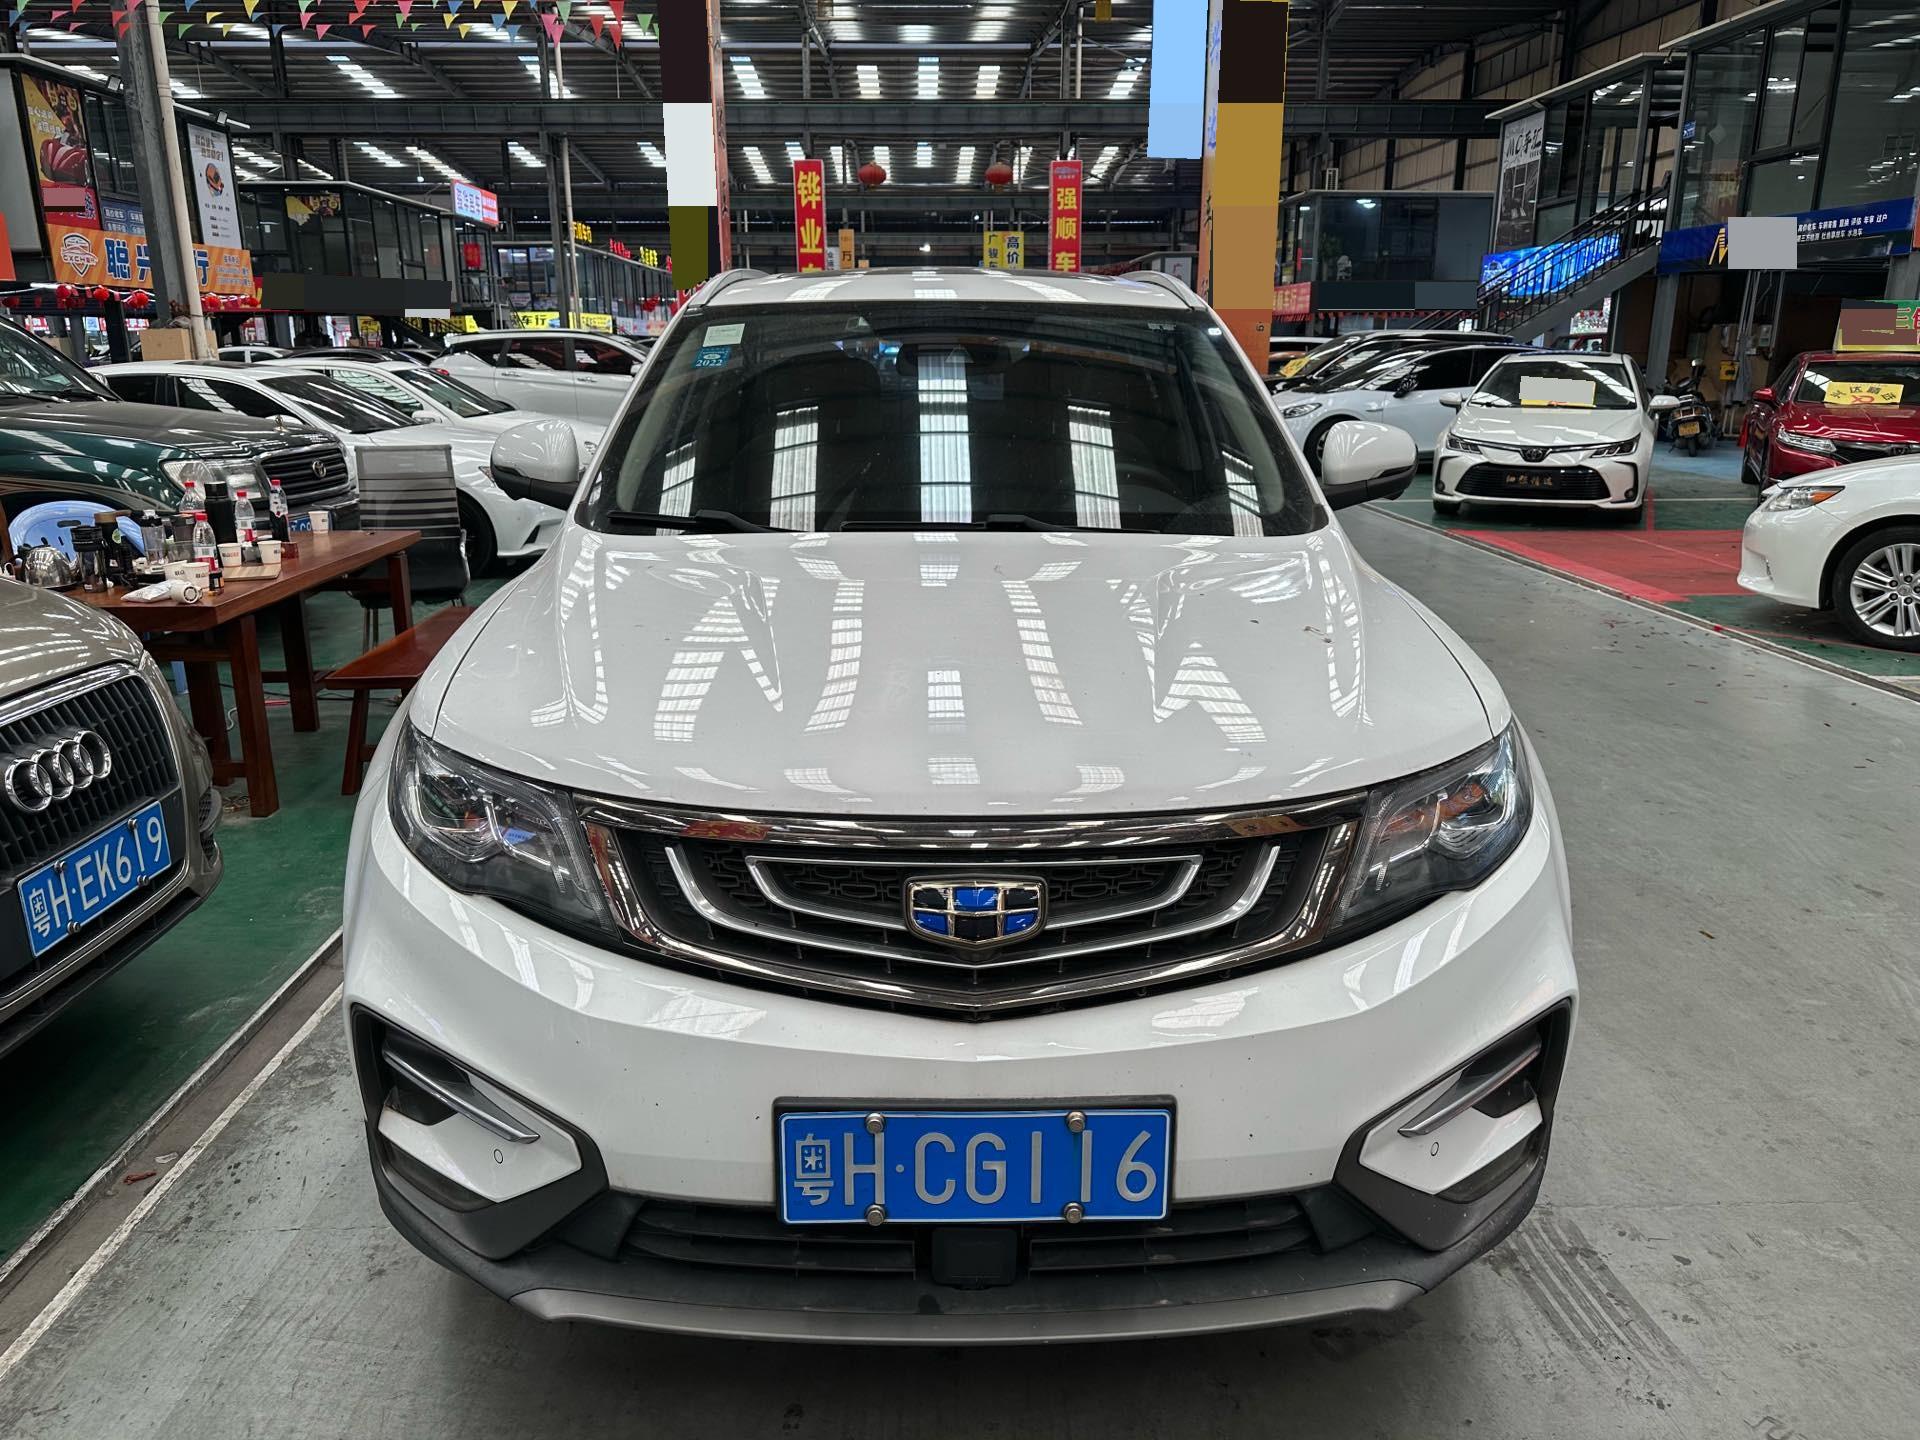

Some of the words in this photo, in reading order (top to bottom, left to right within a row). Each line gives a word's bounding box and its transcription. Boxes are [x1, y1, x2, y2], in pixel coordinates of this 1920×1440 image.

[1055, 187, 1078, 272] 强顺车
[1006, 236, 1020, 268] 高价
[695, 359, 723, 367] 2022
